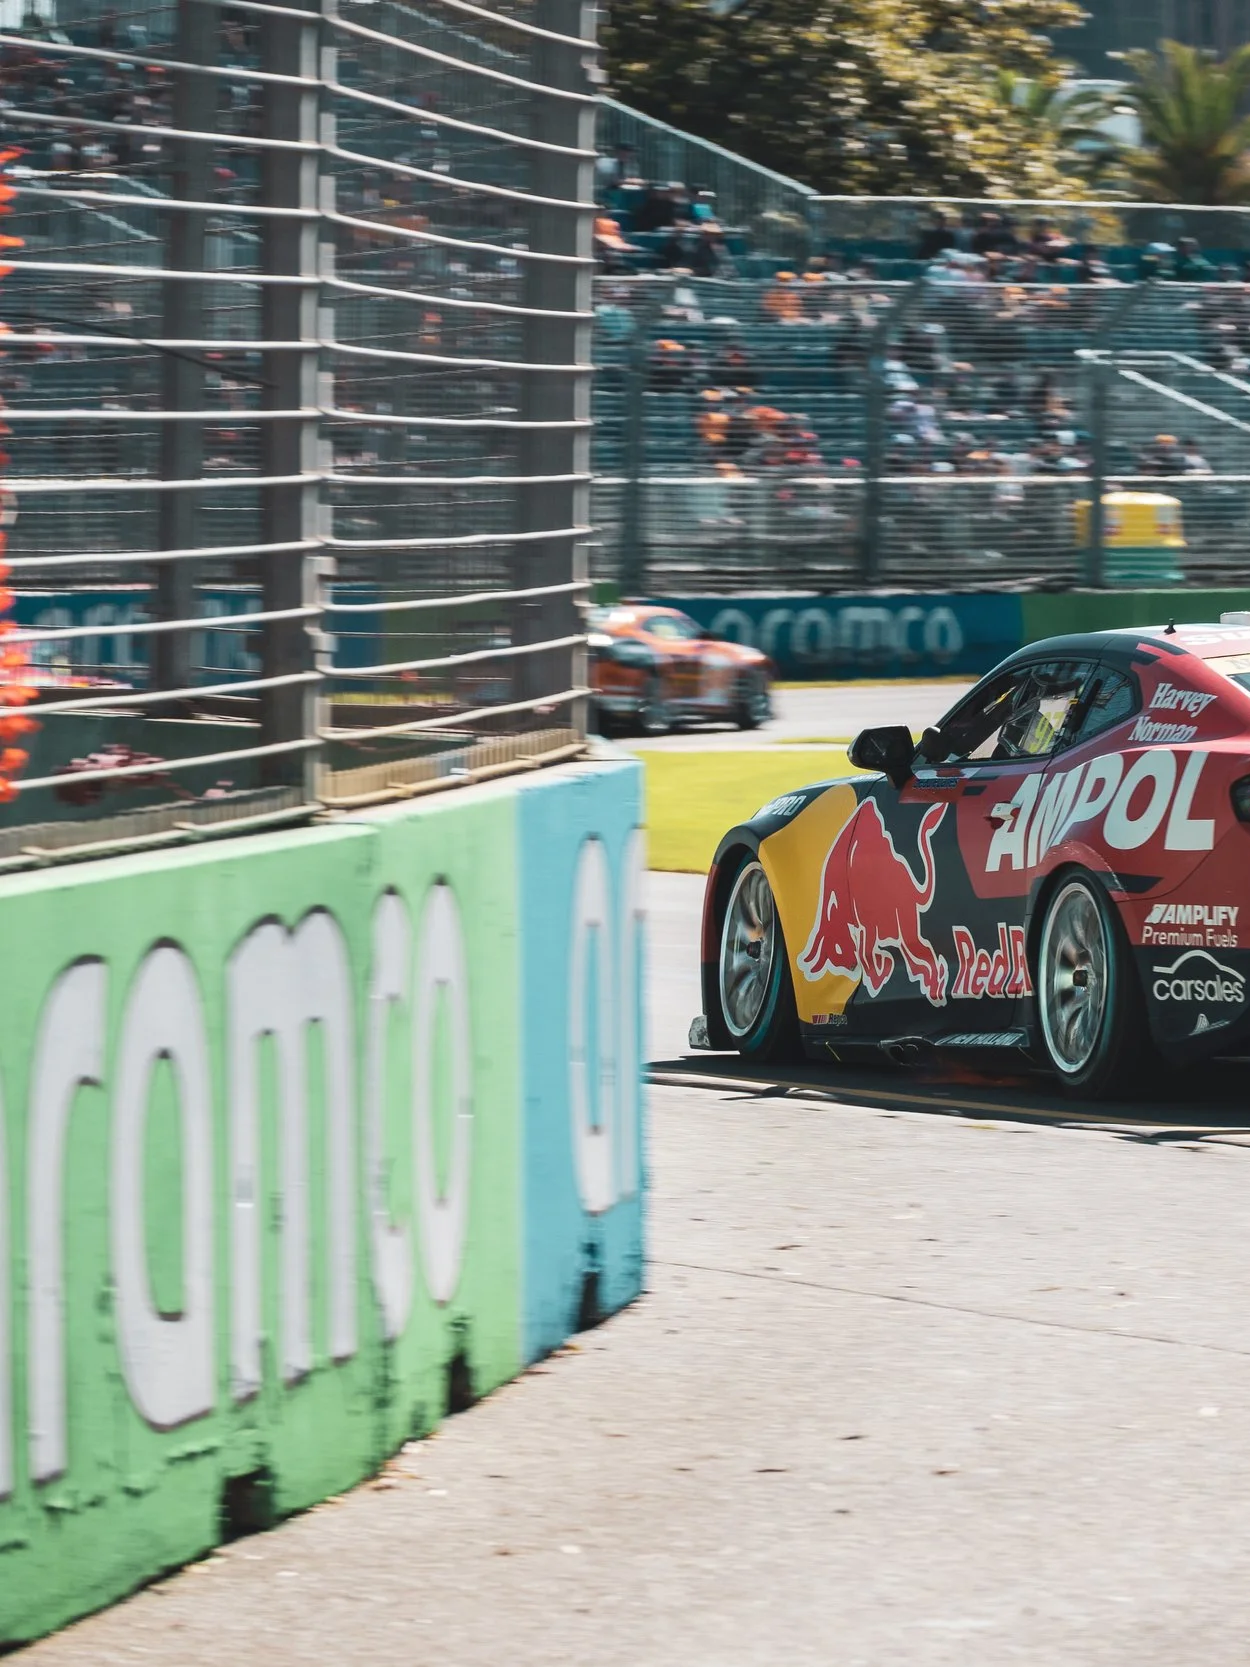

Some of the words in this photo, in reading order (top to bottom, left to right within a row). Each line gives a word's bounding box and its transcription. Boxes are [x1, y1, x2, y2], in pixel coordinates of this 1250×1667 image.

[1149, 682, 1218, 718] Harvey
[1128, 716, 1198, 742] Norman
[985, 748, 1216, 872] AMPOL
[1161, 904, 1239, 926] AMPLIFY
[1141, 926, 1203, 946] Premium
[1206, 928, 1238, 947] Fuels
[951, 922, 1007, 999] Red
[1153, 974, 1245, 1003] carsales
[0, 875, 474, 1502] ramco
